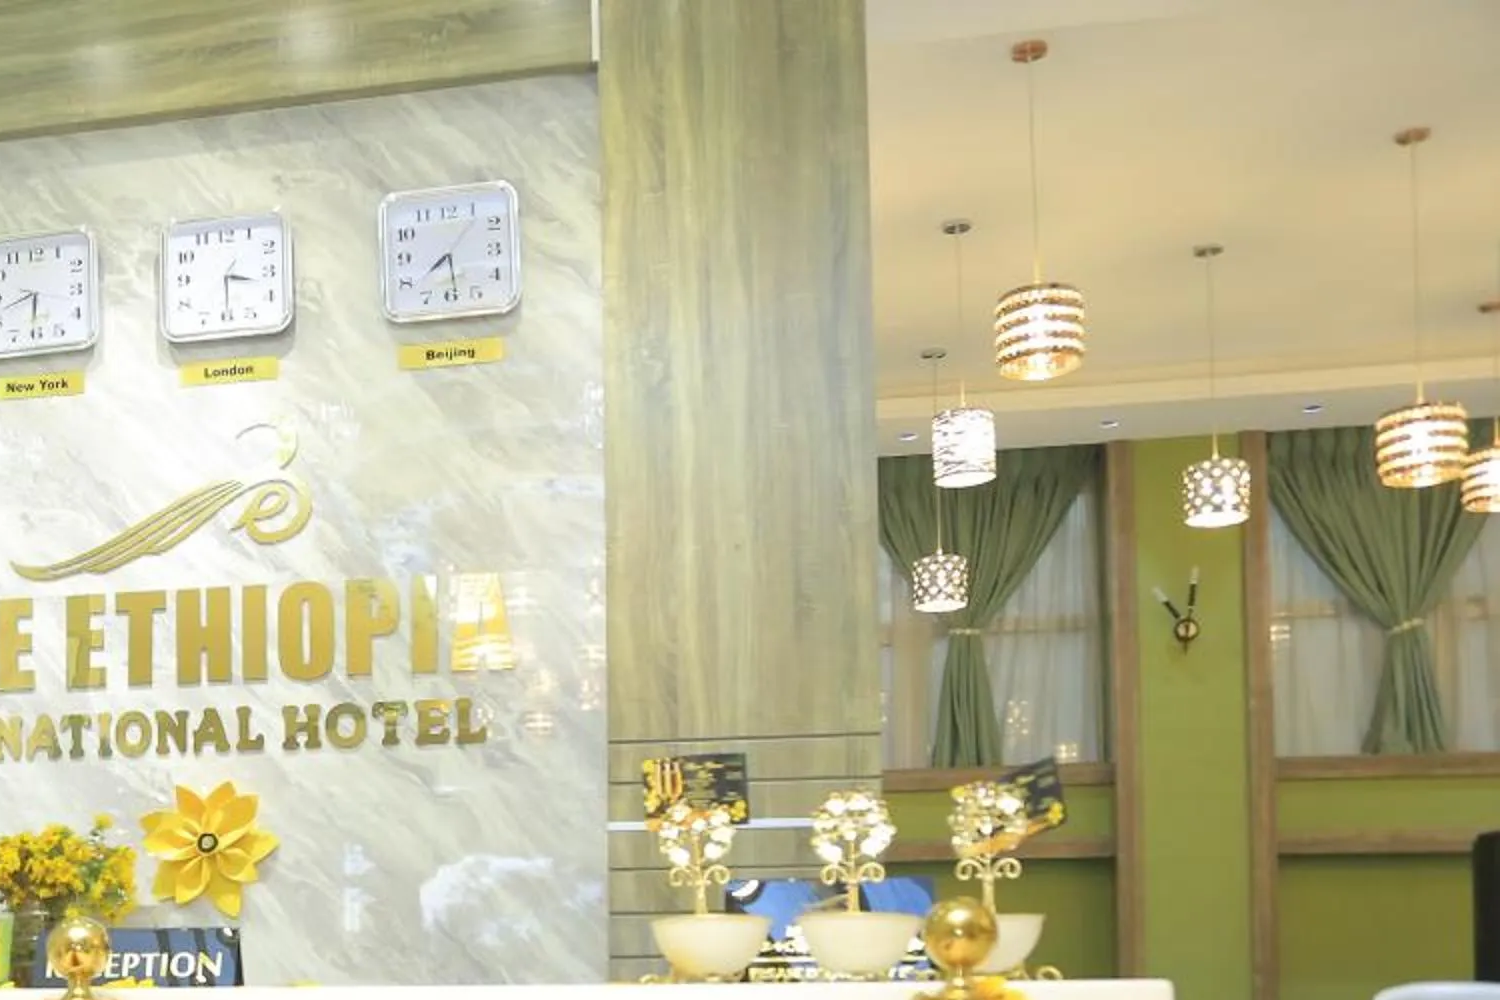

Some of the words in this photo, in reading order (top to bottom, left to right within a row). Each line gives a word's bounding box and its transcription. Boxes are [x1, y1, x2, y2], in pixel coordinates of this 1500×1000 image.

[416, 209, 430, 222] 11
[440, 206, 457, 219] 12
[487, 216, 500, 230] 2
[196, 231, 208, 245] 11
[219, 228, 234, 243] 12
[398, 228, 415, 242] 10
[30, 247, 44, 262] 12
[488, 242, 501, 256] 3
[7, 251, 18, 264] 11
[179, 251, 194, 264] 10
[398, 252, 411, 266] 9
[262, 264, 276, 277] 3
[178, 274, 190, 287] 9
[70, 282, 83, 296] 3
[444, 288, 458, 302] 6
[470, 286, 483, 299] 5
[221, 309, 234, 321] 6
[31, 326, 43, 340] 6
[425, 347, 476, 361] Beijing
[203, 365, 255, 378] London
[6, 382, 35, 393] New
[39, 379, 69, 391] York
[66, 573, 516, 692] ETHIOPIA
[281, 697, 488, 752] HOTEL
[45, 951, 223, 980] EPTION
